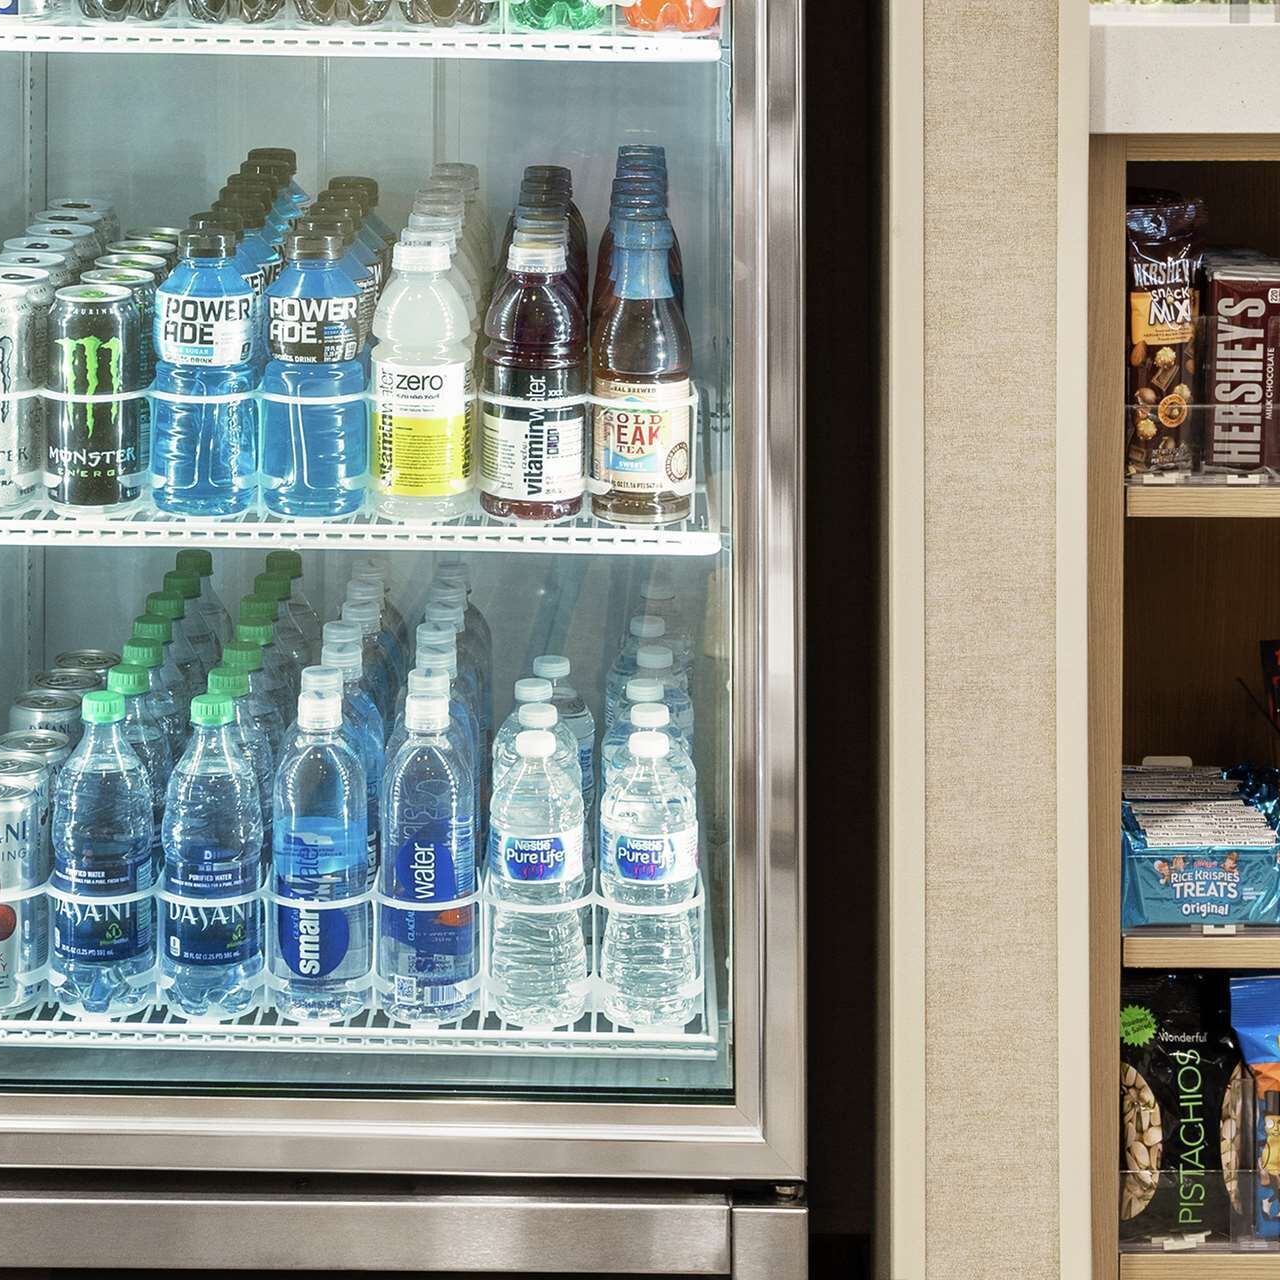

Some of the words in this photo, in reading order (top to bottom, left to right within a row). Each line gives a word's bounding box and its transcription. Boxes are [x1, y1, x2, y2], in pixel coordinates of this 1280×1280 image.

[166, 298, 250, 321] POWER
[270, 298, 357, 321] POWER
[1149, 300, 1191, 325] MIX
[396, 374, 443, 391] zero
[1212, 297, 1266, 463] HERSHEY'S
[1267, 348, 1275, 398] CHOCOLATE
[1266, 401, 1274, 420] MILK
[49, 446, 135, 466] MONSTER
[617, 446, 646, 455] TEA
[506, 849, 538, 864] Pure
[540, 850, 564, 868] Life
[618, 849, 650, 863] Pure
[188, 874, 214, 882] PURIFIED
[1171, 871, 1193, 884] RICE
[1194, 870, 1240, 884] KRISPIES
[1173, 882, 1238, 899] TREATS
[1182, 903, 1229, 917] Original
[1178, 1048, 1205, 1224] PISTACHIOS
